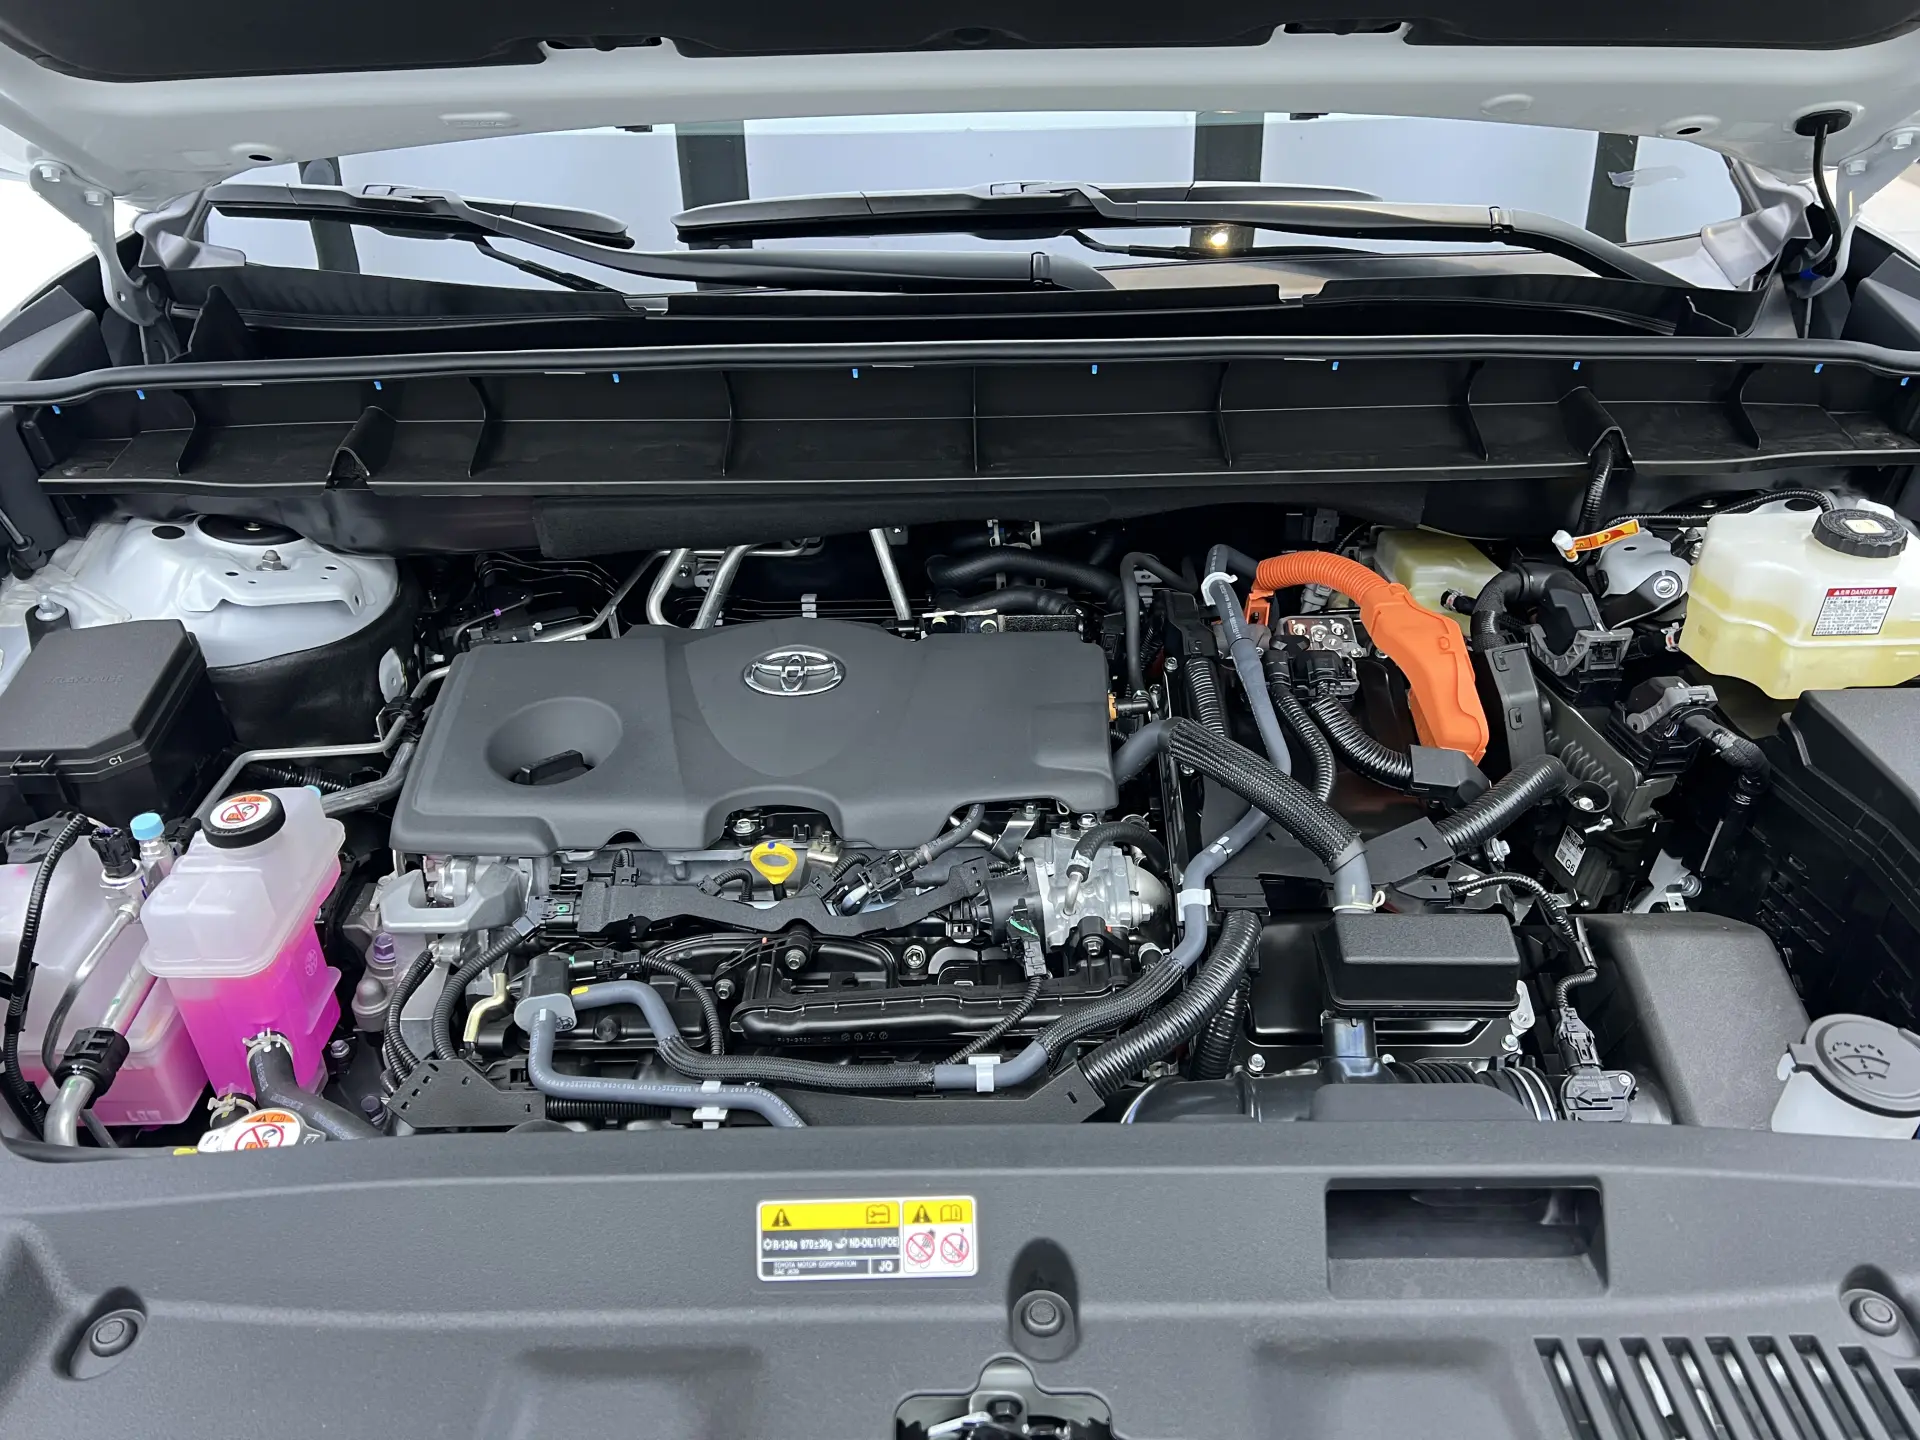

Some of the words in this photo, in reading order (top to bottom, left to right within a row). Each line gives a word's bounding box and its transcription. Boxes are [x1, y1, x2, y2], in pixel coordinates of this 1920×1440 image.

[109, 755, 122, 765] C1
[1566, 859, 1575, 872] G6
[773, 1239, 798, 1250] R-134a
[818, 1260, 857, 1268] CORPORATION
